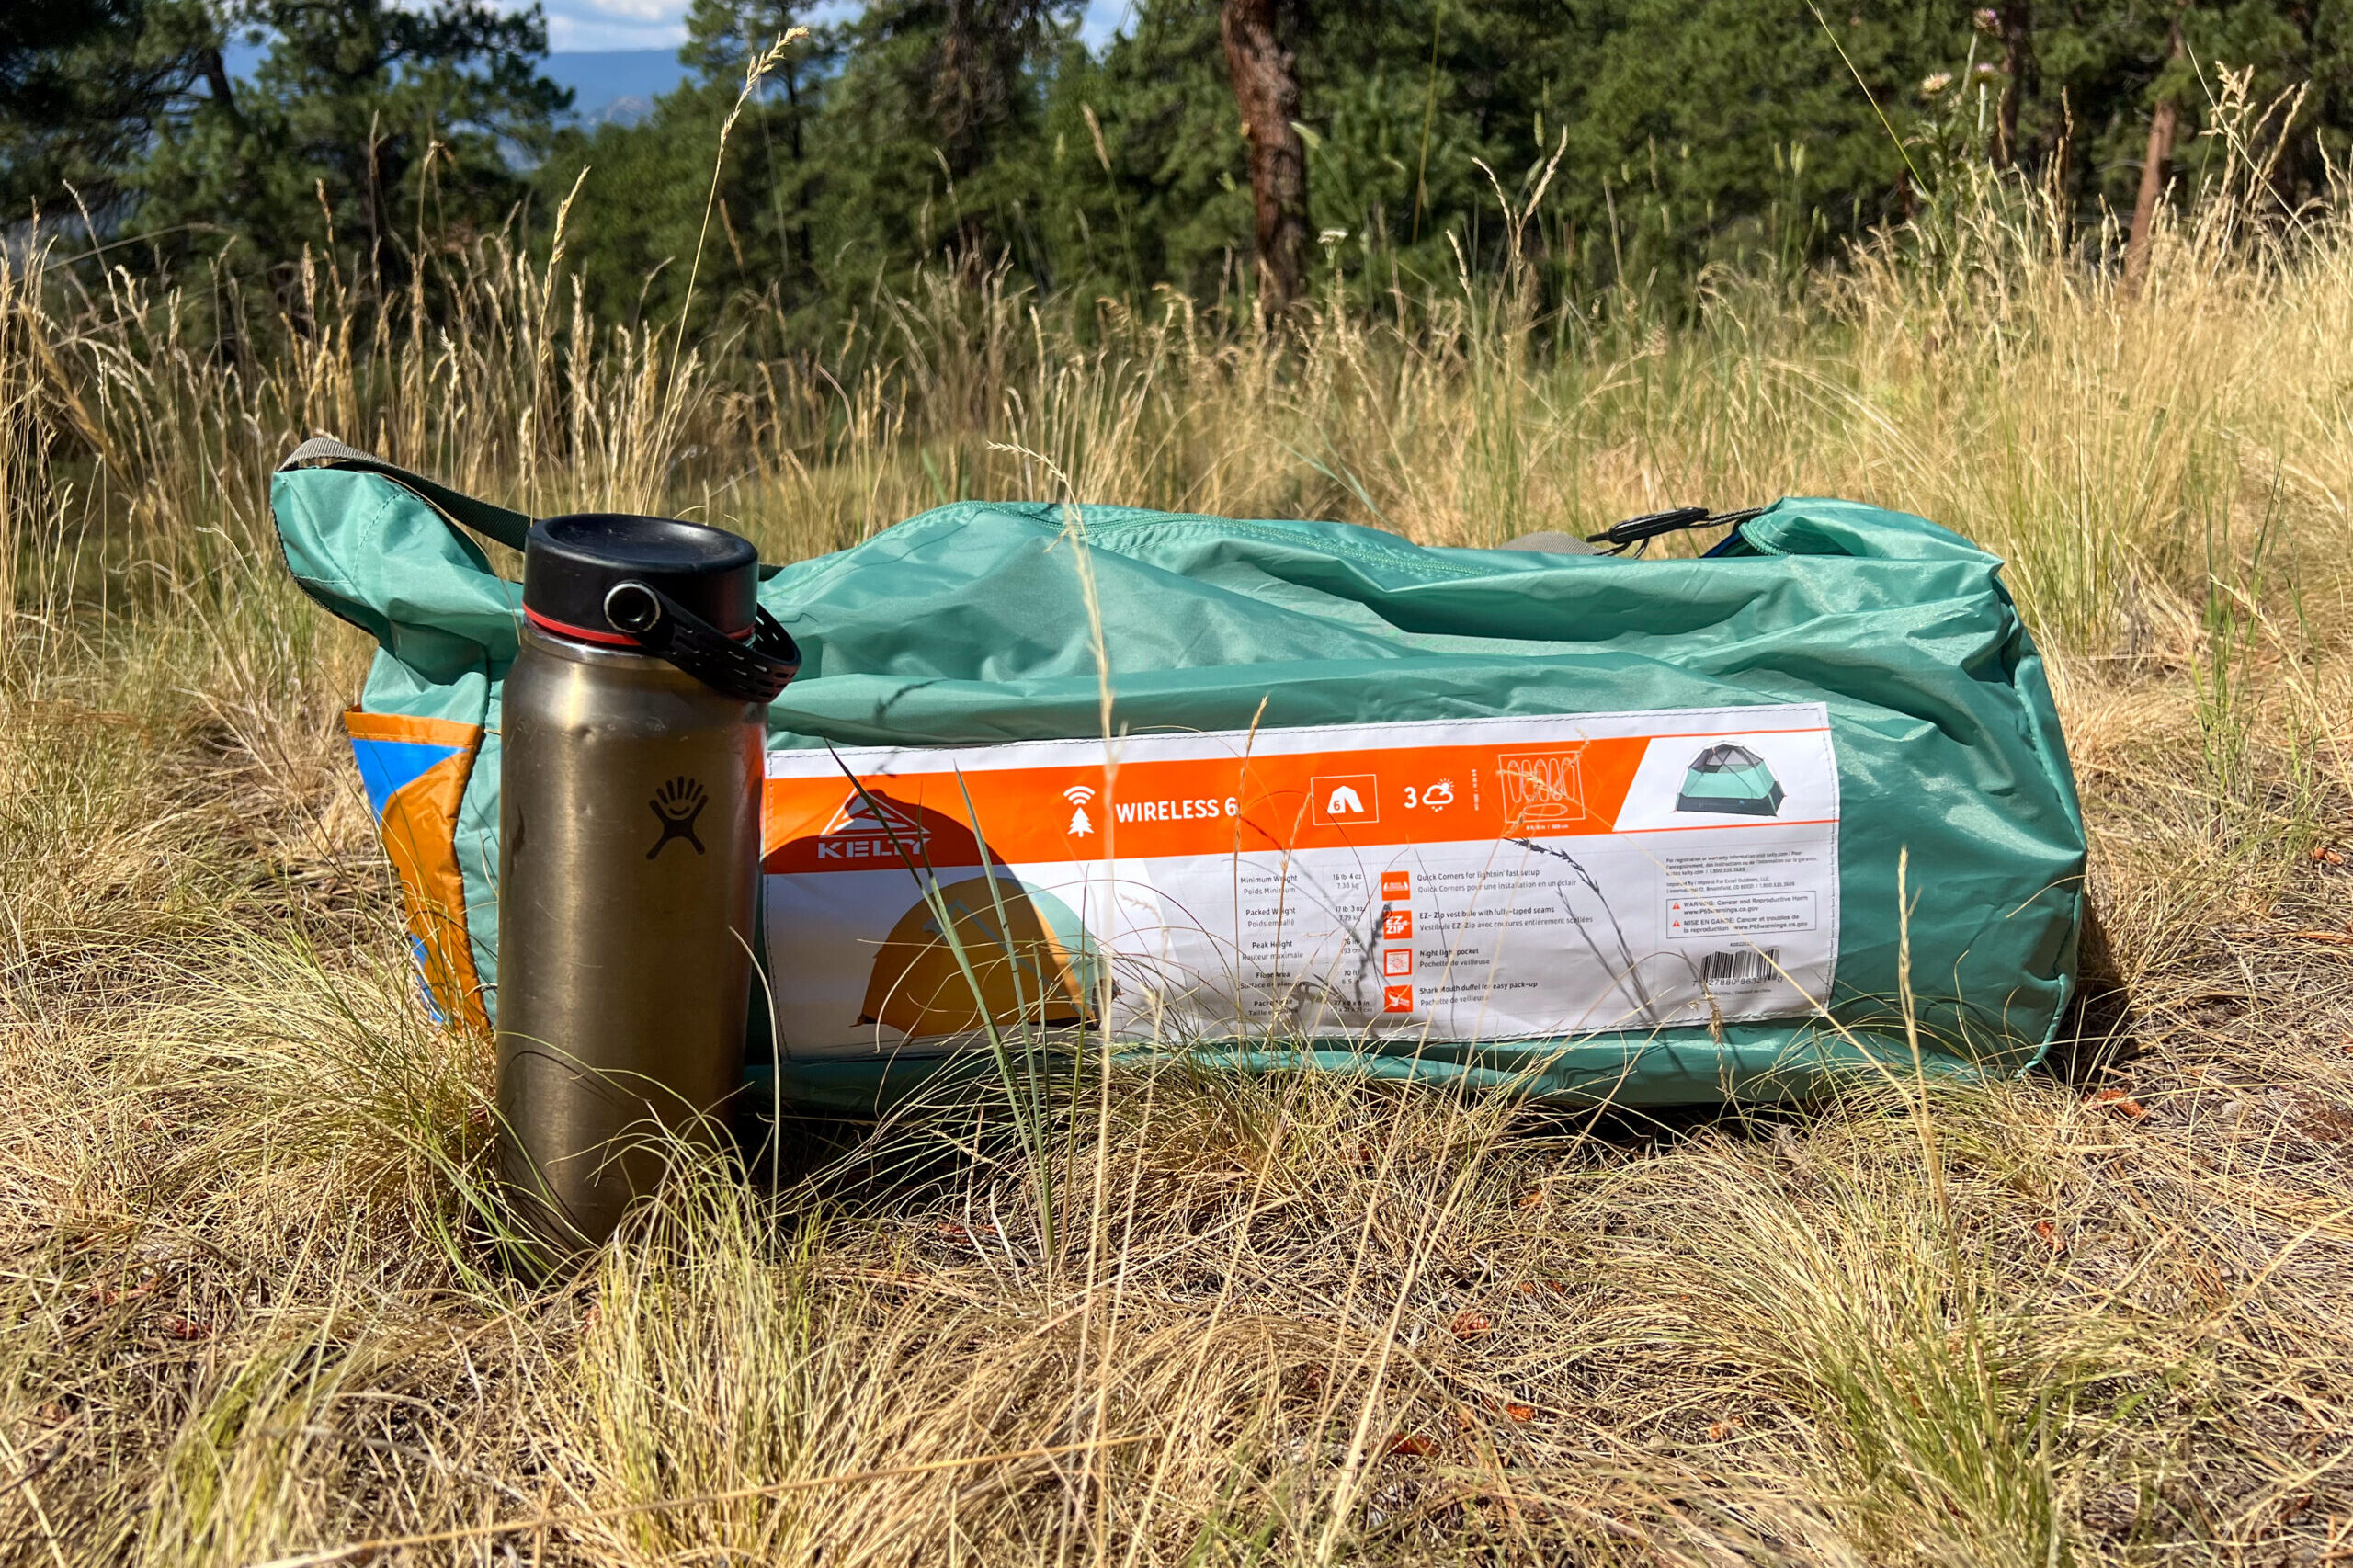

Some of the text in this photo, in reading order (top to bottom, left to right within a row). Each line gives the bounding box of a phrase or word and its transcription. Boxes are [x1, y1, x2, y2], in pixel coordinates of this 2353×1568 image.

[1404, 786, 1418, 809] 3
[1115, 796, 1238, 823] WIRELESS 6
[1333, 800, 1341, 812] 6
[818, 837, 931, 859] KELTY
[1240, 874, 1298, 884] Minimum Wght
[1416, 873, 1437, 881] Quick
[1438, 872, 1465, 881] Corners
[1520, 869, 1540, 877] setup
[1438, 884, 1466, 892] Corners
[1498, 881, 1537, 890] instalation
[1557, 879, 1577, 887] éclair
[1683, 900, 1716, 908] WARNNG:
[1751, 896, 1791, 904] Reproductive
[1245, 907, 1296, 916] Packed Wight
[1446, 908, 1477, 918] vestible
[1478, 908, 1494, 917] with
[1268, 918, 1295, 926] emallé
[1386, 915, 1403, 926] EZ
[1766, 914, 1790, 922] troubles
[1386, 925, 1404, 935] ZIP
[1419, 923, 1451, 931] Vestibule
[1494, 919, 1523, 928] cotures
[1690, 926, 1729, 934] reproduction
[1269, 940, 1293, 949] Hight
[1242, 951, 1304, 960] Hauteur maximale
[1438, 949, 1454, 958] ligh
[1456, 948, 1480, 956] pocket
[1419, 960, 1449, 968] Pochette
[1460, 958, 1490, 966] veilleuse
[1274, 971, 1290, 979] Area
[1708, 978, 1737, 986] 27880
[1418, 986, 1438, 995] Shark
[1461, 983, 1481, 993] duffel
[1481, 983, 1491, 991] fo
[1492, 983, 1508, 991] easy
[1509, 981, 1538, 990] pack-up
